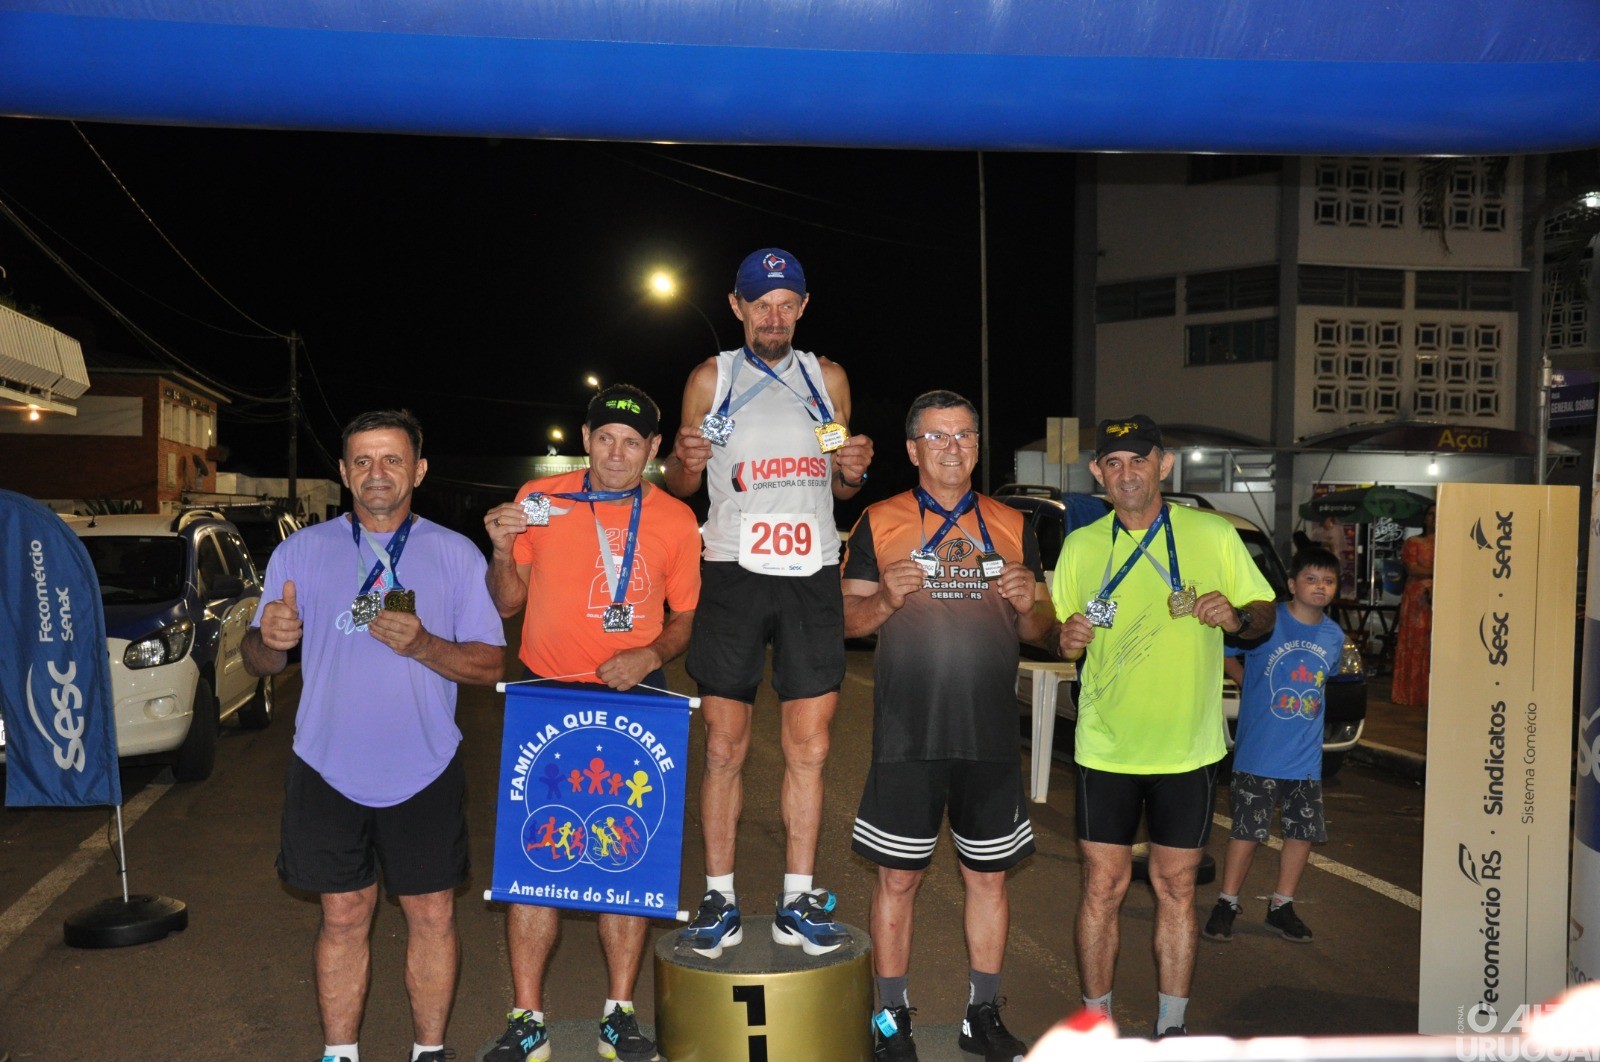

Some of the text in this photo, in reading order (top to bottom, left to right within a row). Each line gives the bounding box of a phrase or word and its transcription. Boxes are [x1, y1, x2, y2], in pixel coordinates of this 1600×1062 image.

[1437, 429, 1490, 453] Açaí
[751, 456, 827, 480] KAPASS
[752, 480, 796, 490] CORRETORA
[797, 479, 807, 487] DE
[750, 521, 812, 556] 269
[29, 540, 54, 643] Fecomércio
[922, 579, 989, 590] Academia
[970, 592, 982, 600] RS
[1284, 640, 1300, 651] QUE
[1300, 640, 1327, 657] CORRE
[510, 710, 675, 801] FAMÍLIA QUE CORRE
[1484, 700, 1507, 816] Sindicatos
[1521, 702, 1537, 824] Sistema Comércio
[1481, 849, 1502, 880] RS
[509, 880, 579, 901] Ametista
[583, 886, 602, 902] do
[606, 888, 630, 905] Sul
[644, 892, 664, 908] RS
[519, 1030, 541, 1054] FILA
[603, 1024, 619, 1045] FILA
